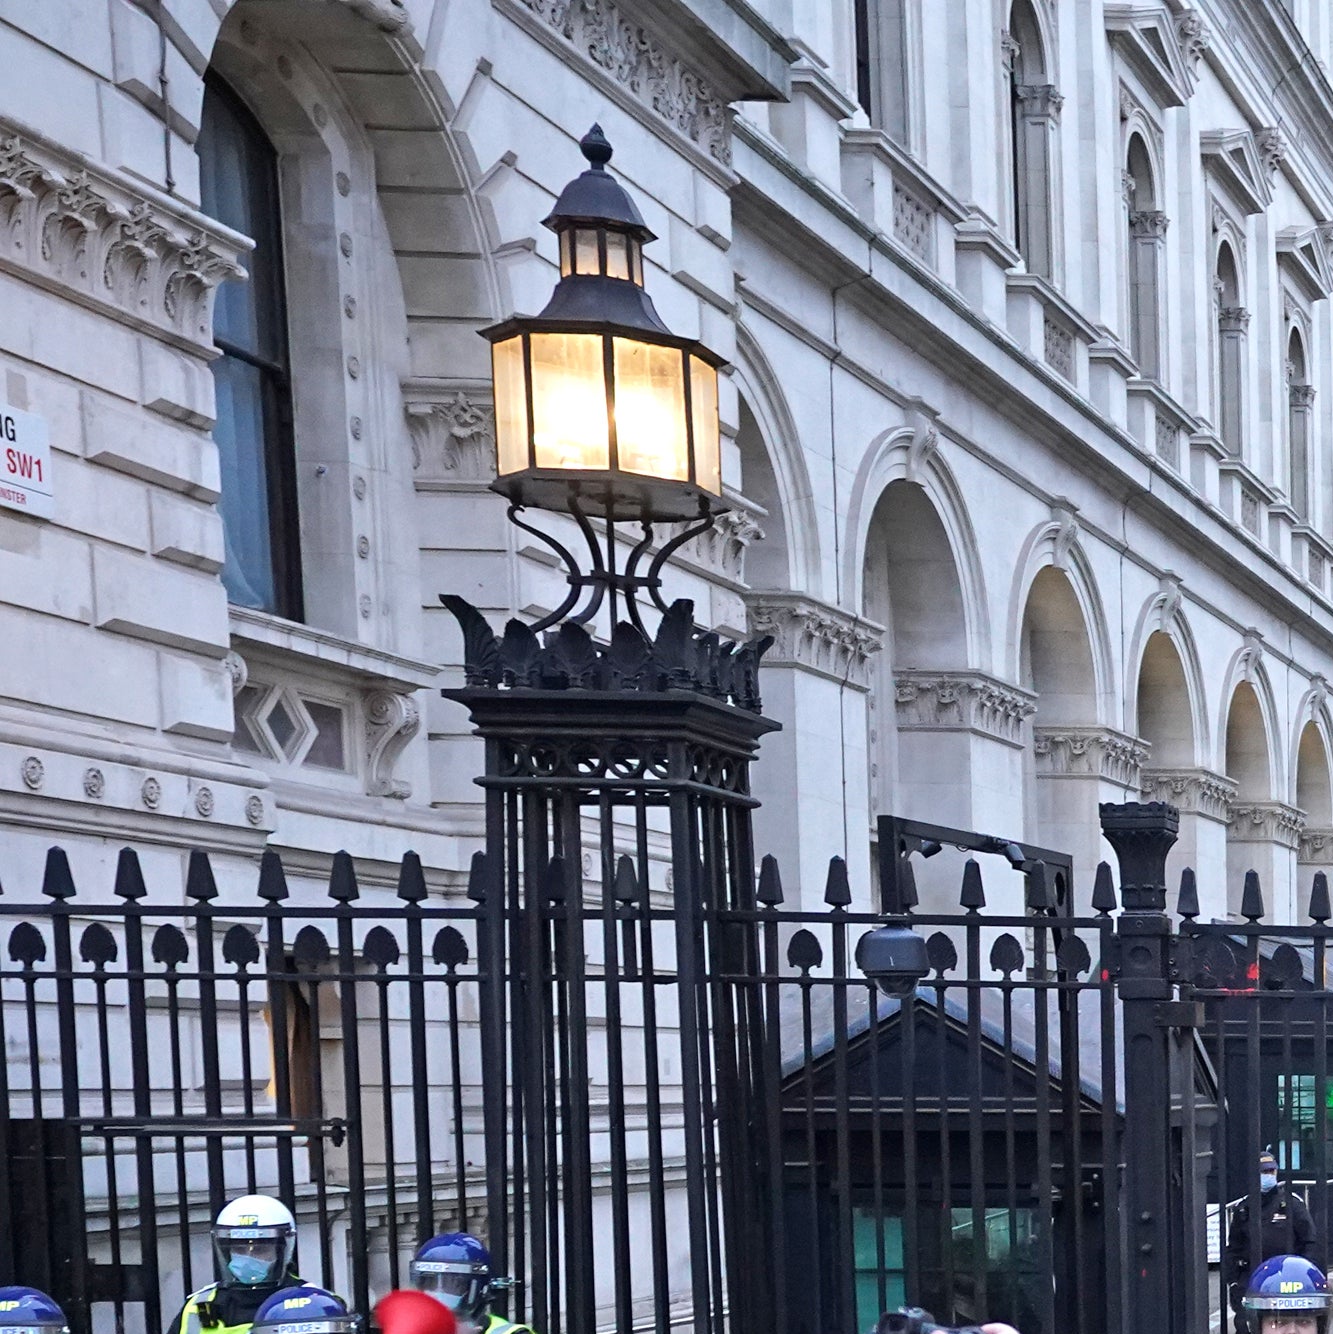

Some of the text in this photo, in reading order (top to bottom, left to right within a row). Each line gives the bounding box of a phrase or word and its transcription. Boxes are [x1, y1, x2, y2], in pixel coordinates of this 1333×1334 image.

[6, 448, 43, 482] SW1
[1280, 1281, 1304, 1294] MP
[283, 1297, 312, 1310] MP
[1278, 1299, 1308, 1308] POLICE
[280, 1323, 313, 1334] POLICE
